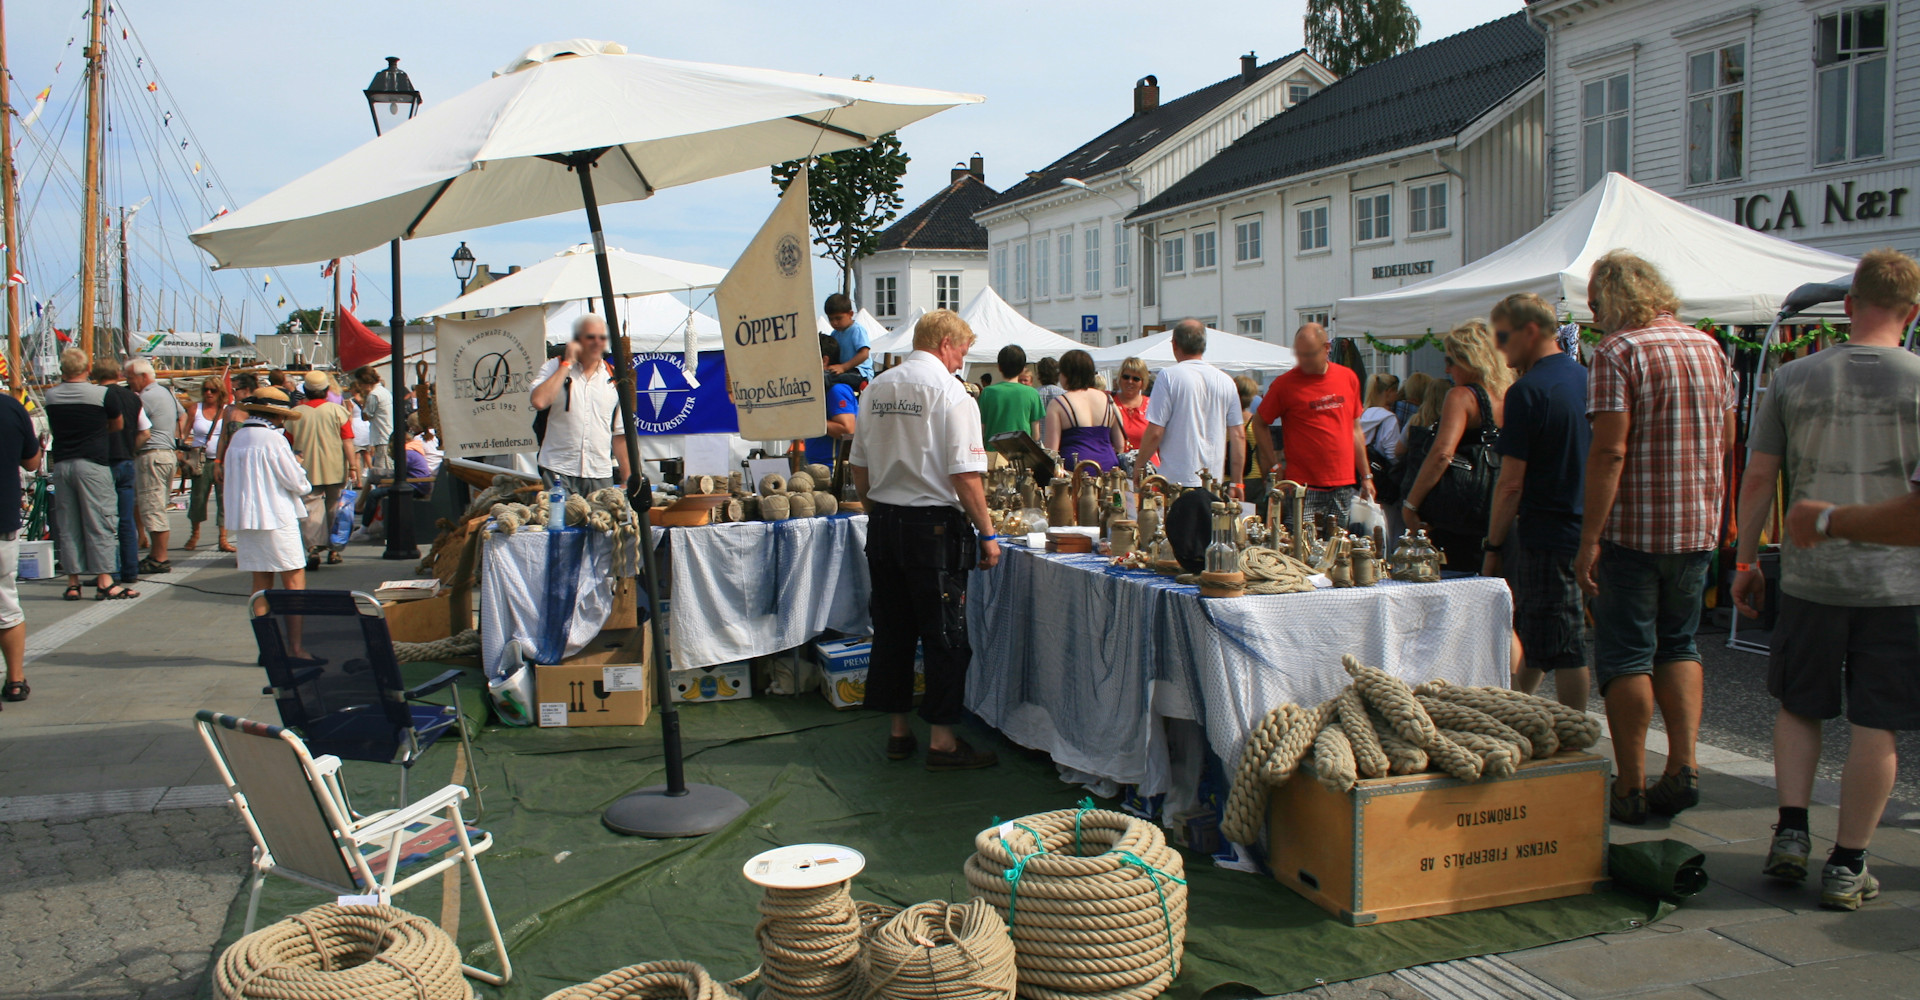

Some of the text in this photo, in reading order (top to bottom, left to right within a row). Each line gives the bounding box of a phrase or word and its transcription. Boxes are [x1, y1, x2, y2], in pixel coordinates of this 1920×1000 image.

[1733, 181, 1909, 231] ICA Nær
[1372, 260, 1434, 279] BEDEHUSET
[735, 312, 799, 346] ÖPPET
[1085, 317, 1095, 331] P
[466, 329, 502, 346] HANDMADE
[632, 352, 687, 372] ERUDSTRAN
[453, 371, 534, 399] FENDERS
[472, 402, 517, 416] SINCE 1992
[459, 438, 533, 450] www.d-fenders.no
[843, 656, 870, 668] PREMI
[1457, 805, 1527, 827] STRÖMSTAD
[1516, 840, 1558, 860] SVENSK
[1420, 857, 1435, 871] AB
